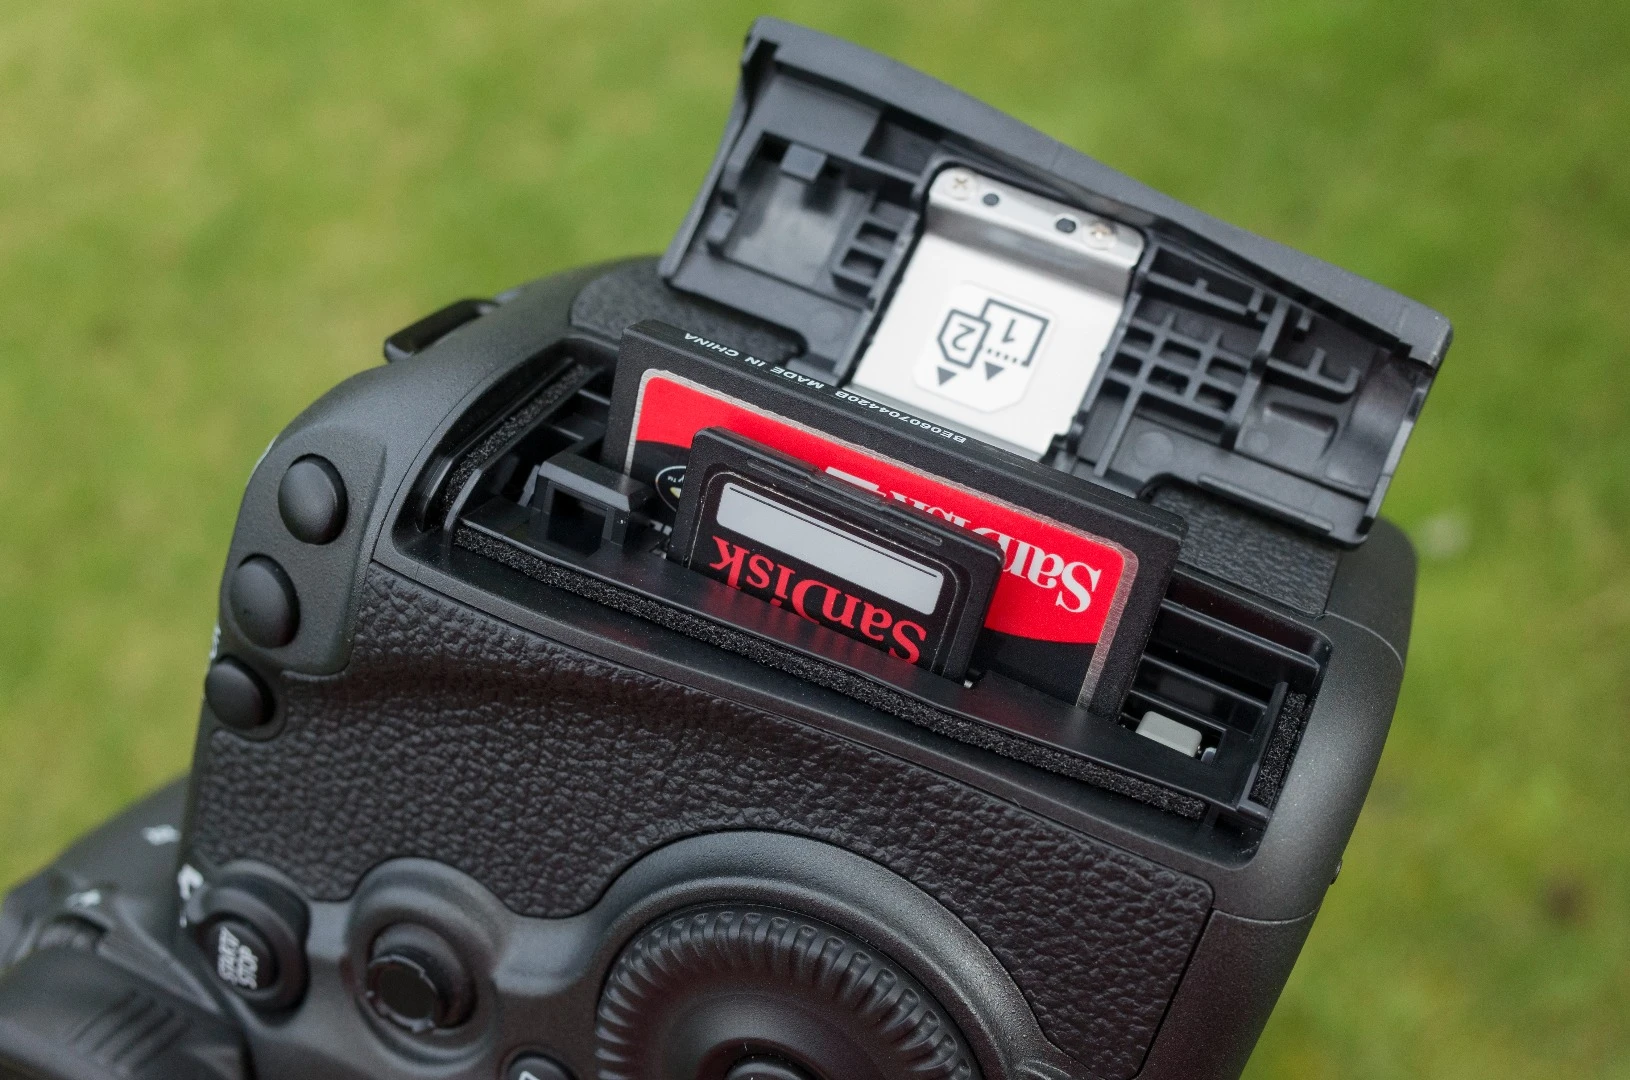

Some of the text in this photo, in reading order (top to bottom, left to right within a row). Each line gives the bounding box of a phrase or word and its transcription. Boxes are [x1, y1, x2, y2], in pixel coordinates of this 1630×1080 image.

[951, 323, 976, 352] 2
[1001, 318, 1017, 344] 1
[684, 332, 968, 445] BE060704420B MADE IN CHINA
[708, 535, 927, 665] SanDisk
[217, 926, 241, 986] START
[237, 944, 259, 990] STOP
